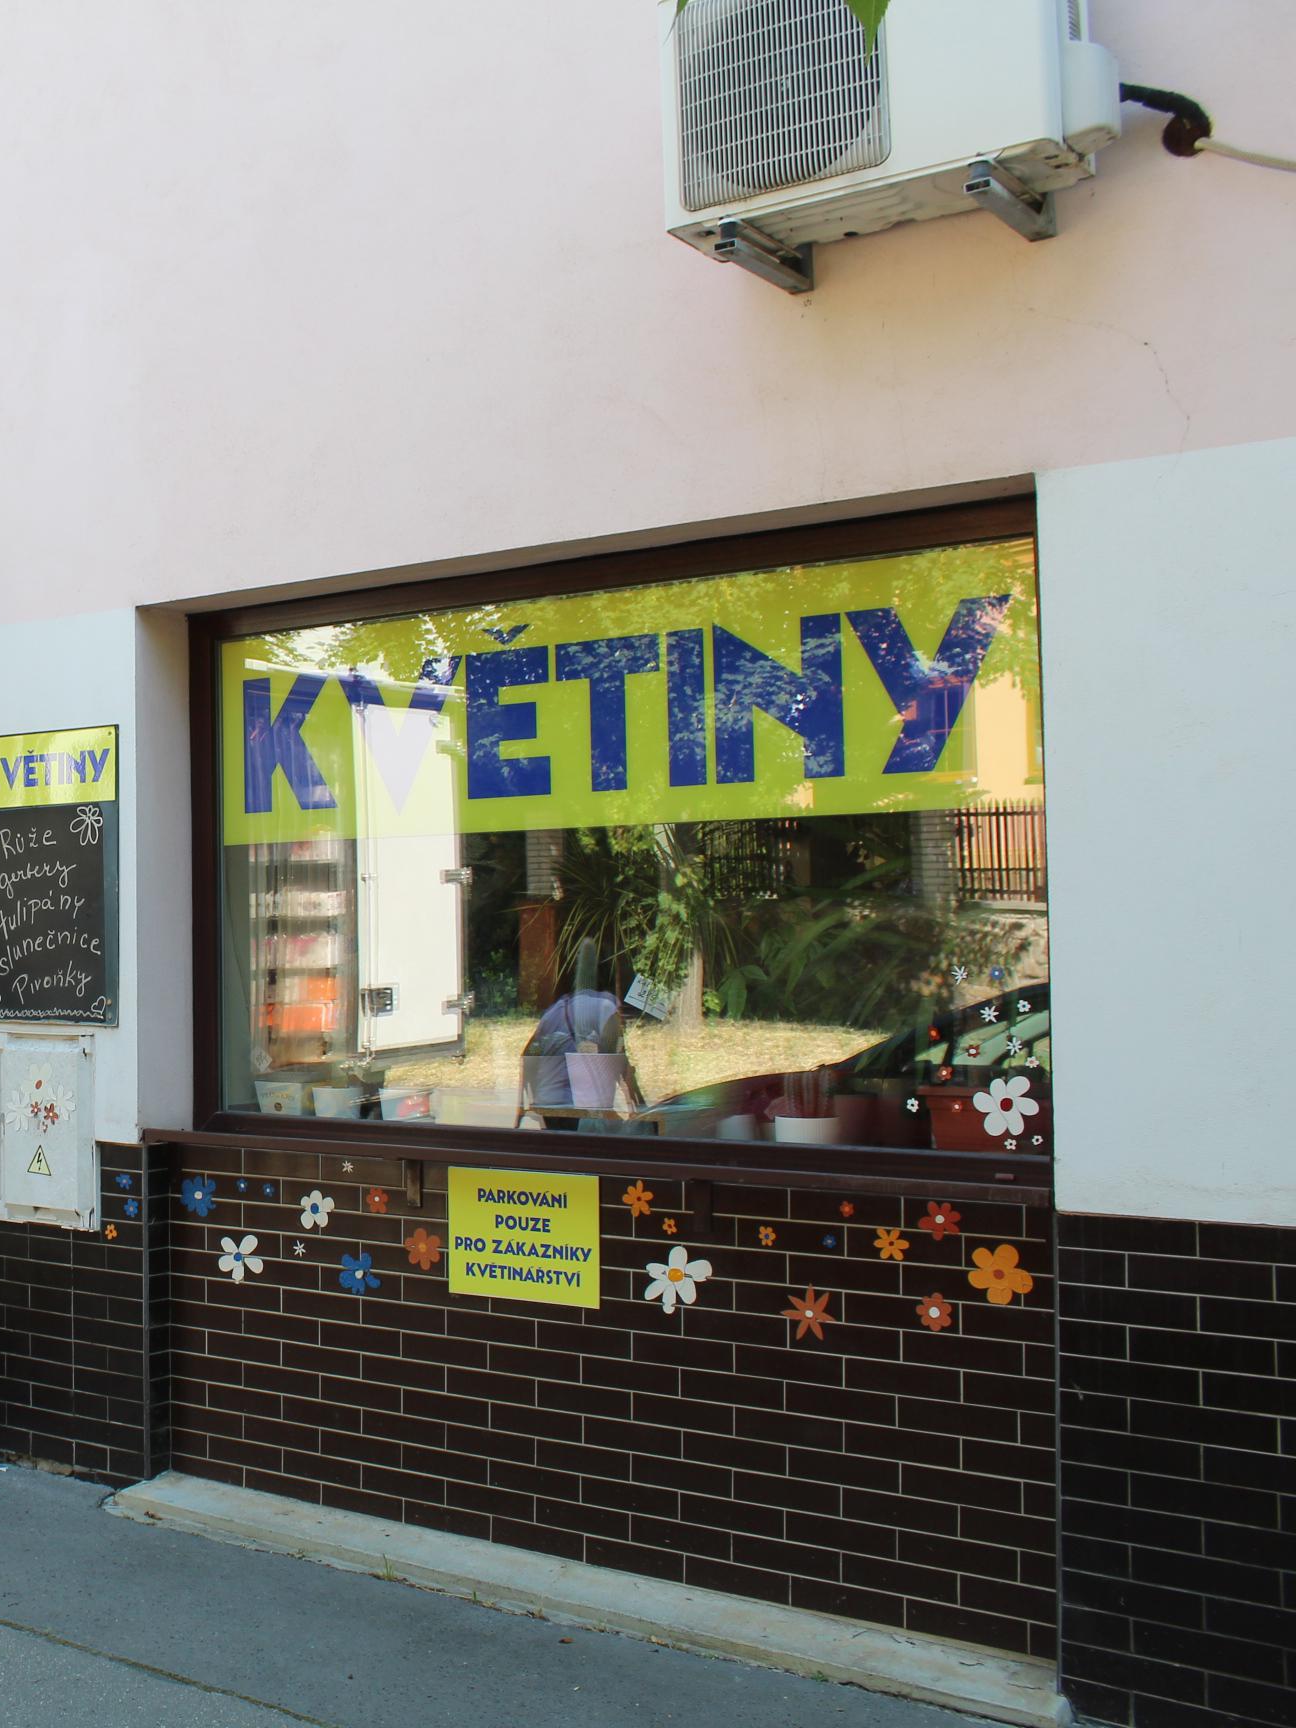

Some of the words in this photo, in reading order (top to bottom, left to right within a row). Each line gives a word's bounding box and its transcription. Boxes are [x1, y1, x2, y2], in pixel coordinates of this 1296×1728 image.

[243, 594, 1012, 816] KVĚTINY
[11, 960, 92, 1005] Pivoňky
[477, 1187, 568, 1209] PARKOVÁNÍ
[495, 1214, 551, 1233] POUZE
[454, 1236, 486, 1253] PRO
[492, 1238, 592, 1263] ZÁKAZNÍKY
[465, 1261, 581, 1288] KVĚTINÁŘSTVÍ
